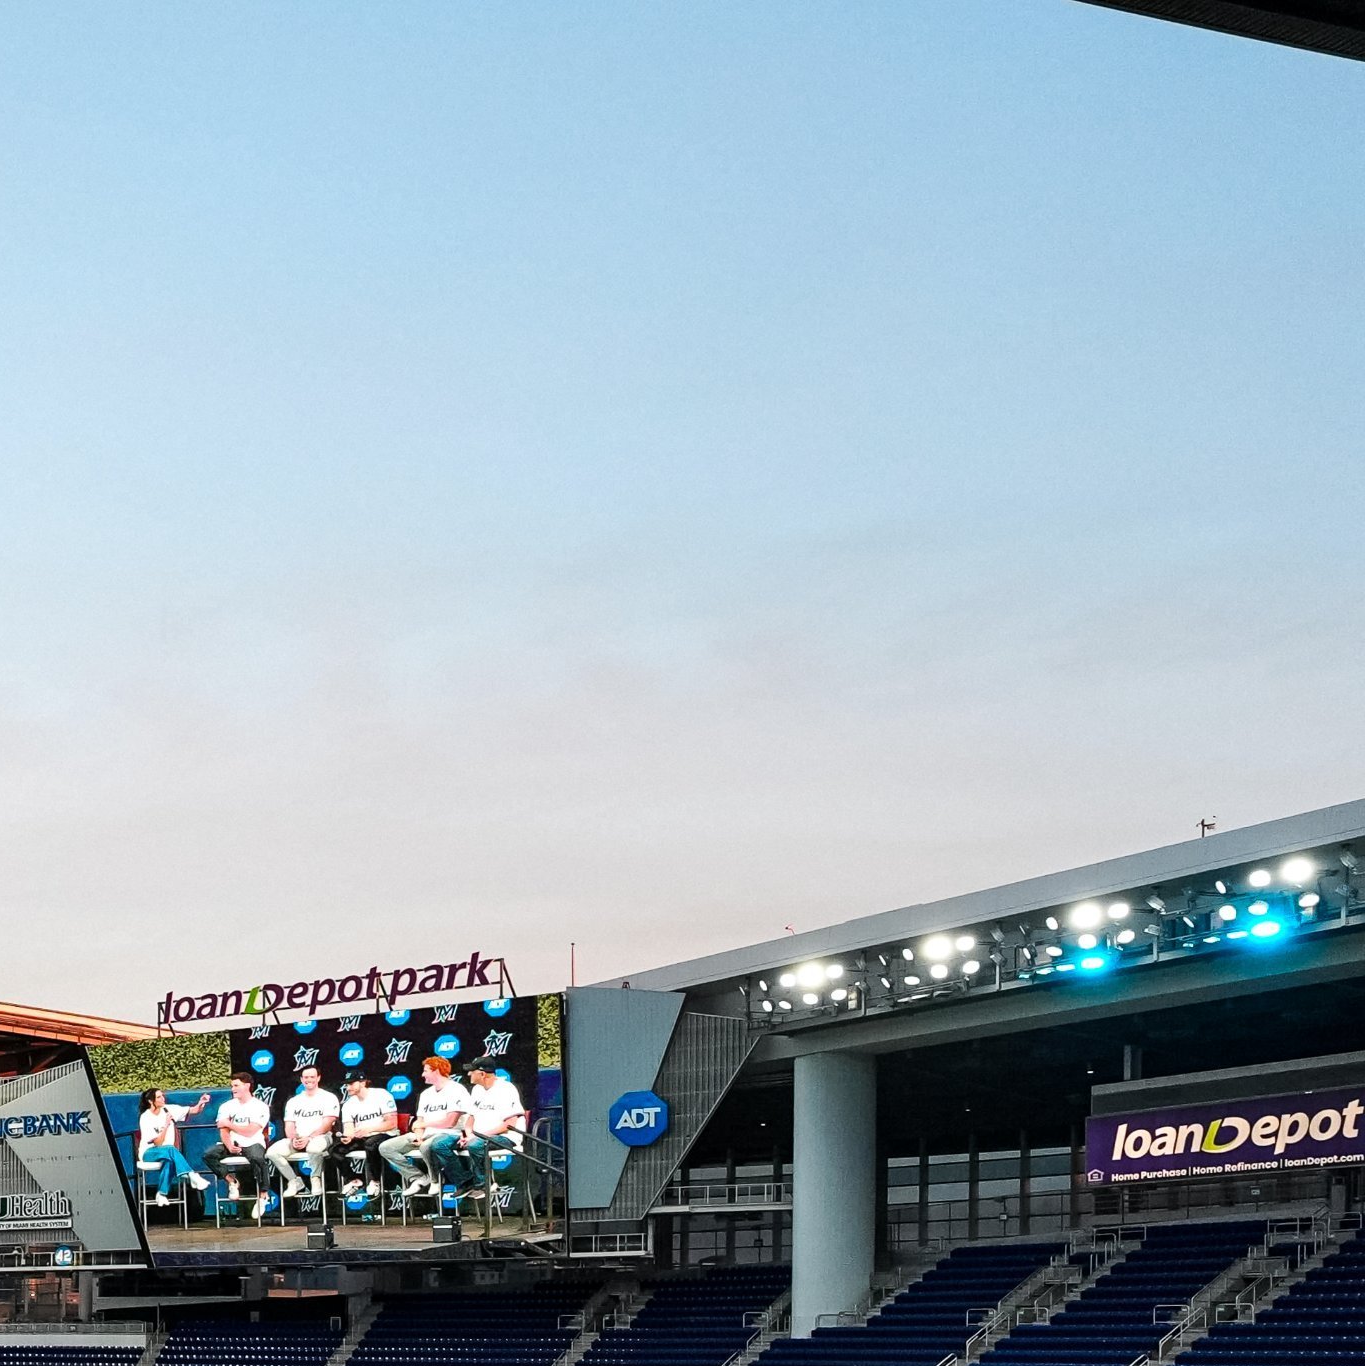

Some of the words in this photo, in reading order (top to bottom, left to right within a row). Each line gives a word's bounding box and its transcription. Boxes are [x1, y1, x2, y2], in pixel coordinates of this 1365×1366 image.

[165, 966, 381, 1024] loanDepot
[389, 952, 494, 1006] park
[615, 1107, 661, 1129] ADT
[1112, 1100, 1364, 1161] loanDepot
[1111, 1173, 1139, 1182] Home
[1141, 1168, 1187, 1179] Purchase
[1193, 1165, 1222, 1175] Home
[1225, 1160, 1278, 1172] Refinance
[1285, 1154, 1364, 1168] loanDepot.com
[55, 1250, 72, 1262] 42
